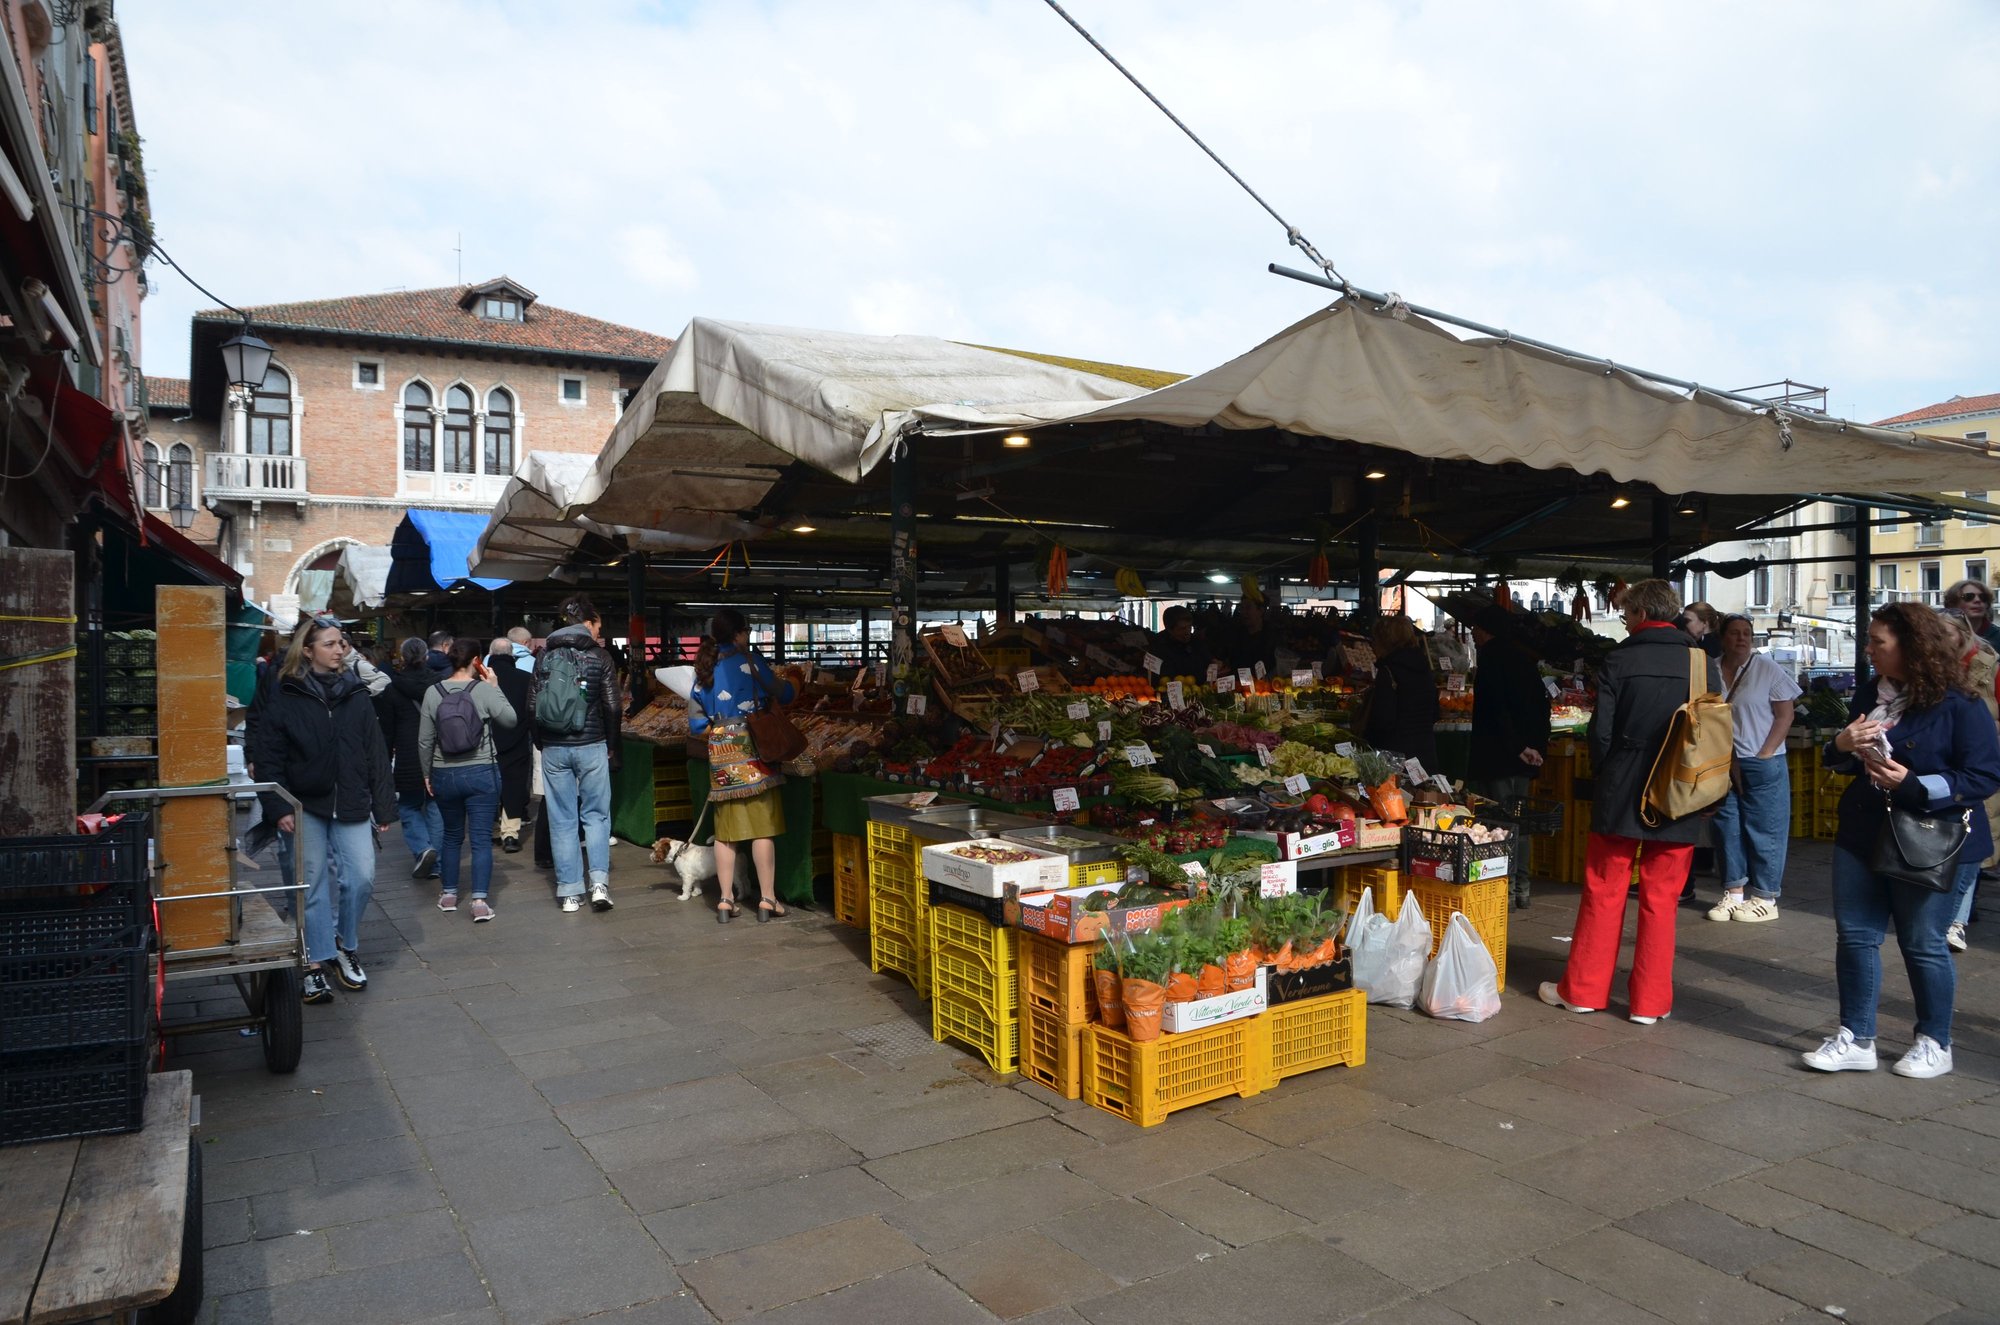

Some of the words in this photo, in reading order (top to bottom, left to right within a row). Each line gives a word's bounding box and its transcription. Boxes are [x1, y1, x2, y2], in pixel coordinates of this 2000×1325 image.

[1023, 907, 1045, 921] DOLCE
[1126, 907, 1158, 921] DOLCE
[1126, 919, 1158, 931] DOLC
[1189, 1005, 1223, 1019] Vittoria
[1225, 998, 1252, 1013] Verde
